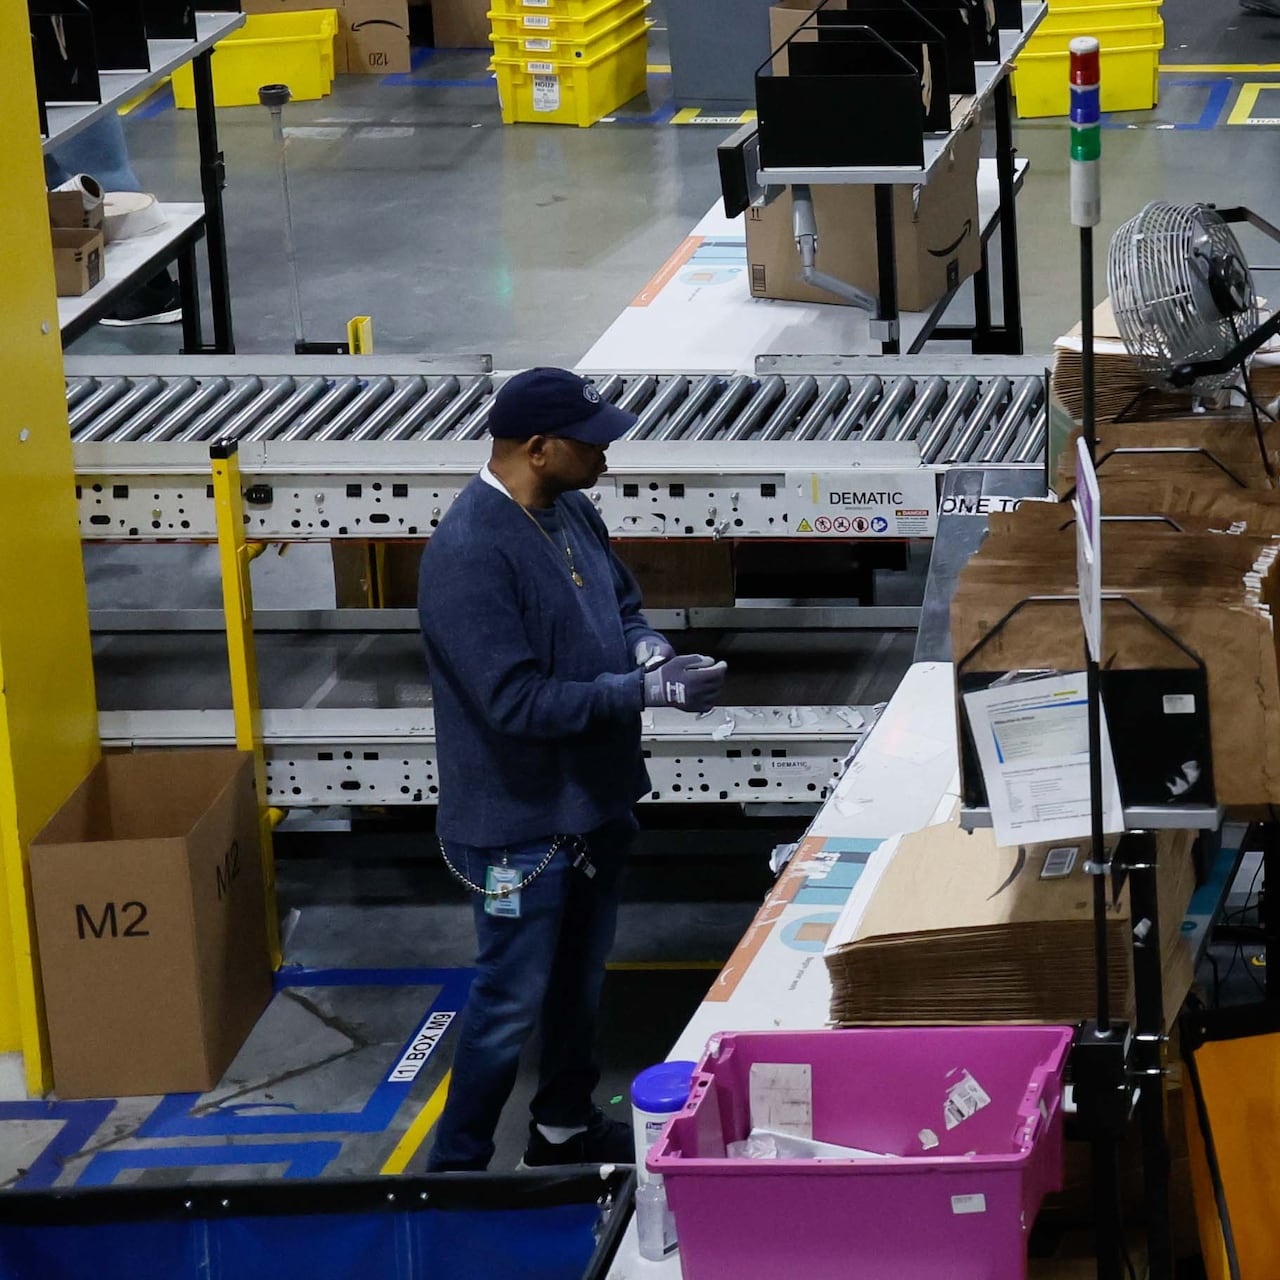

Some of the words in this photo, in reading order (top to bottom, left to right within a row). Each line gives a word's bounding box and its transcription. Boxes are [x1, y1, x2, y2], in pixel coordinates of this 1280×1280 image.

[829, 491, 904, 506] DEMATIC
[941, 498, 990, 516] ONE
[775, 760, 809, 769] DEMATIC
[215, 837, 241, 901] M2
[76, 901, 150, 941] M2
[394, 1064, 415, 1081] (1)
[406, 1031, 437, 1062] BOX
[428, 1013, 452, 1032] M9
